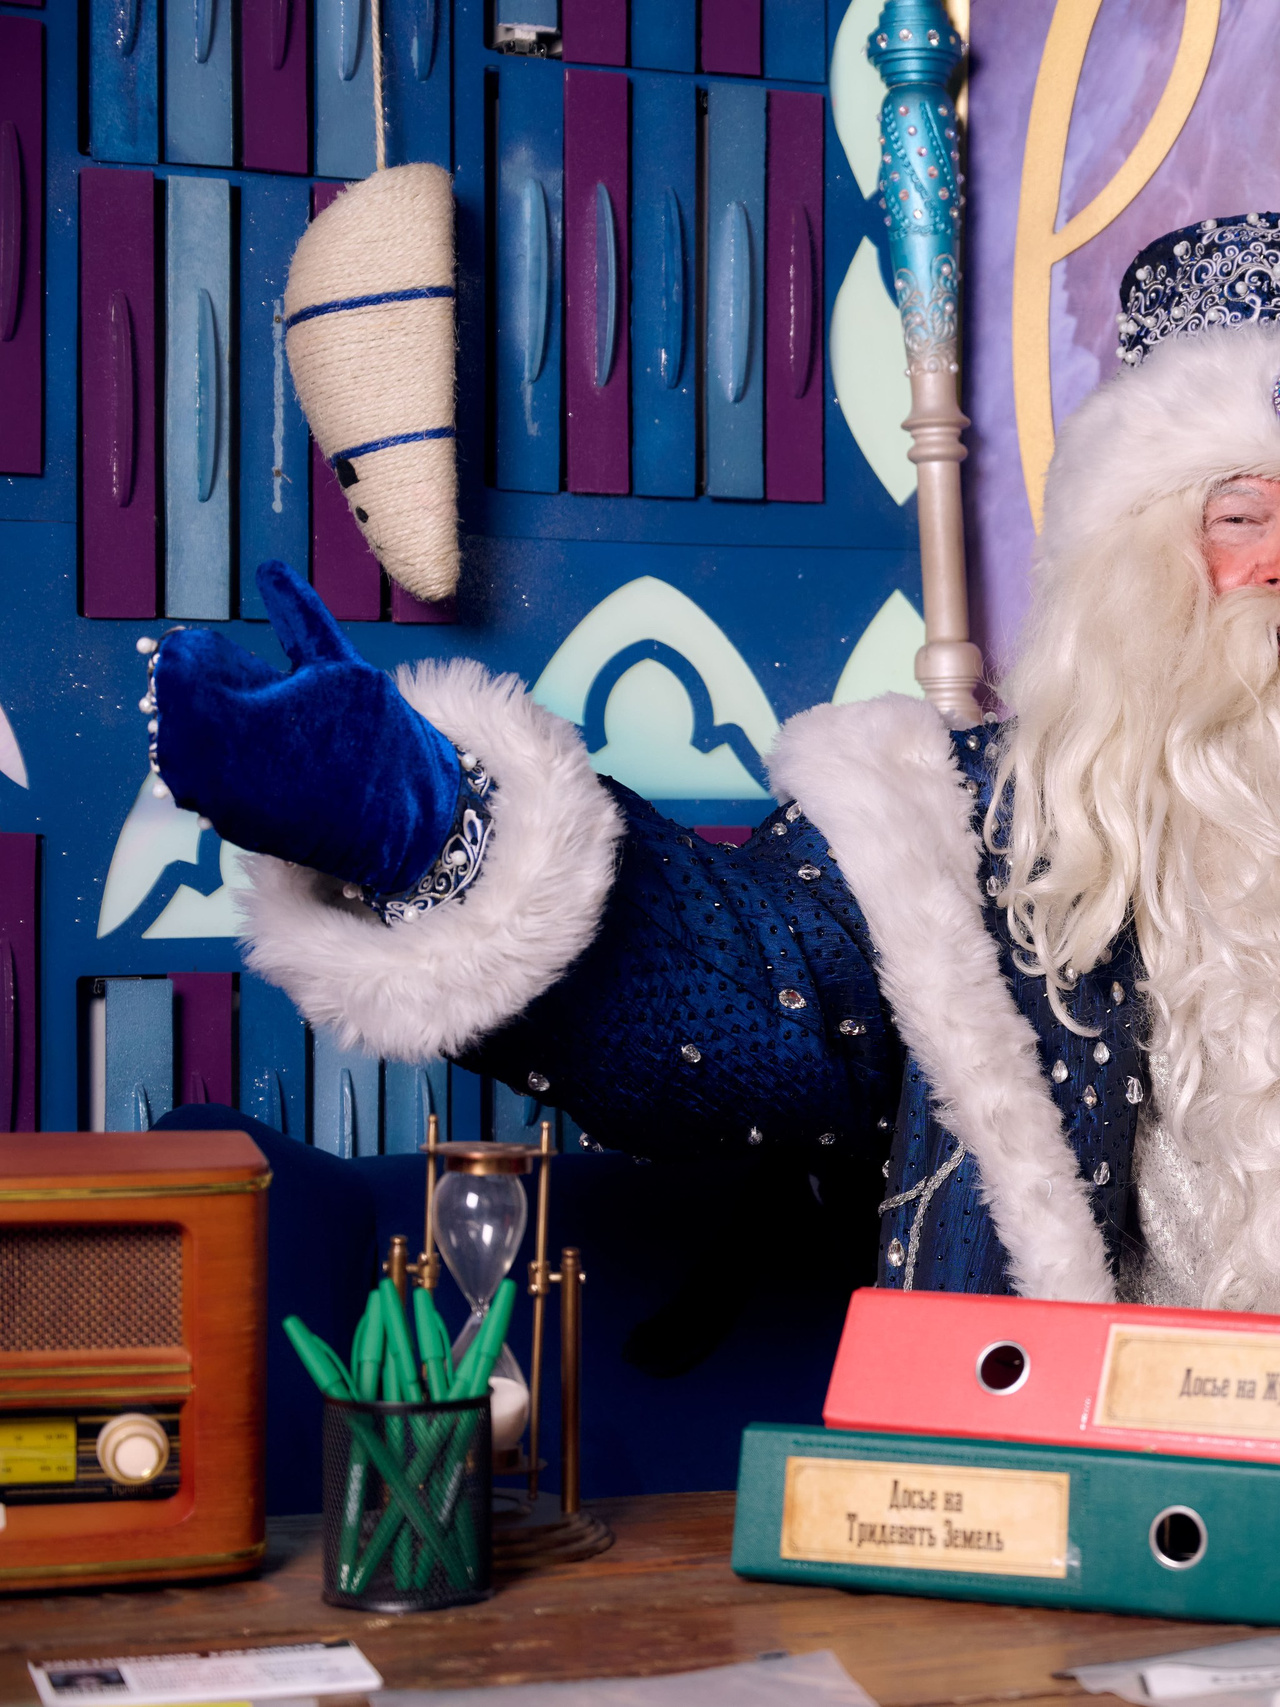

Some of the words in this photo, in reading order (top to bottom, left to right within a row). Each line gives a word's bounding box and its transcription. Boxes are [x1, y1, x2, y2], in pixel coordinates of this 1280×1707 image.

[1179, 1367, 1230, 1398] Досье
[1235, 1379, 1257, 1400] на
[889, 1479, 937, 1511] Досье
[943, 1491, 964, 1512] на
[943, 1519, 1005, 1551] Земель
